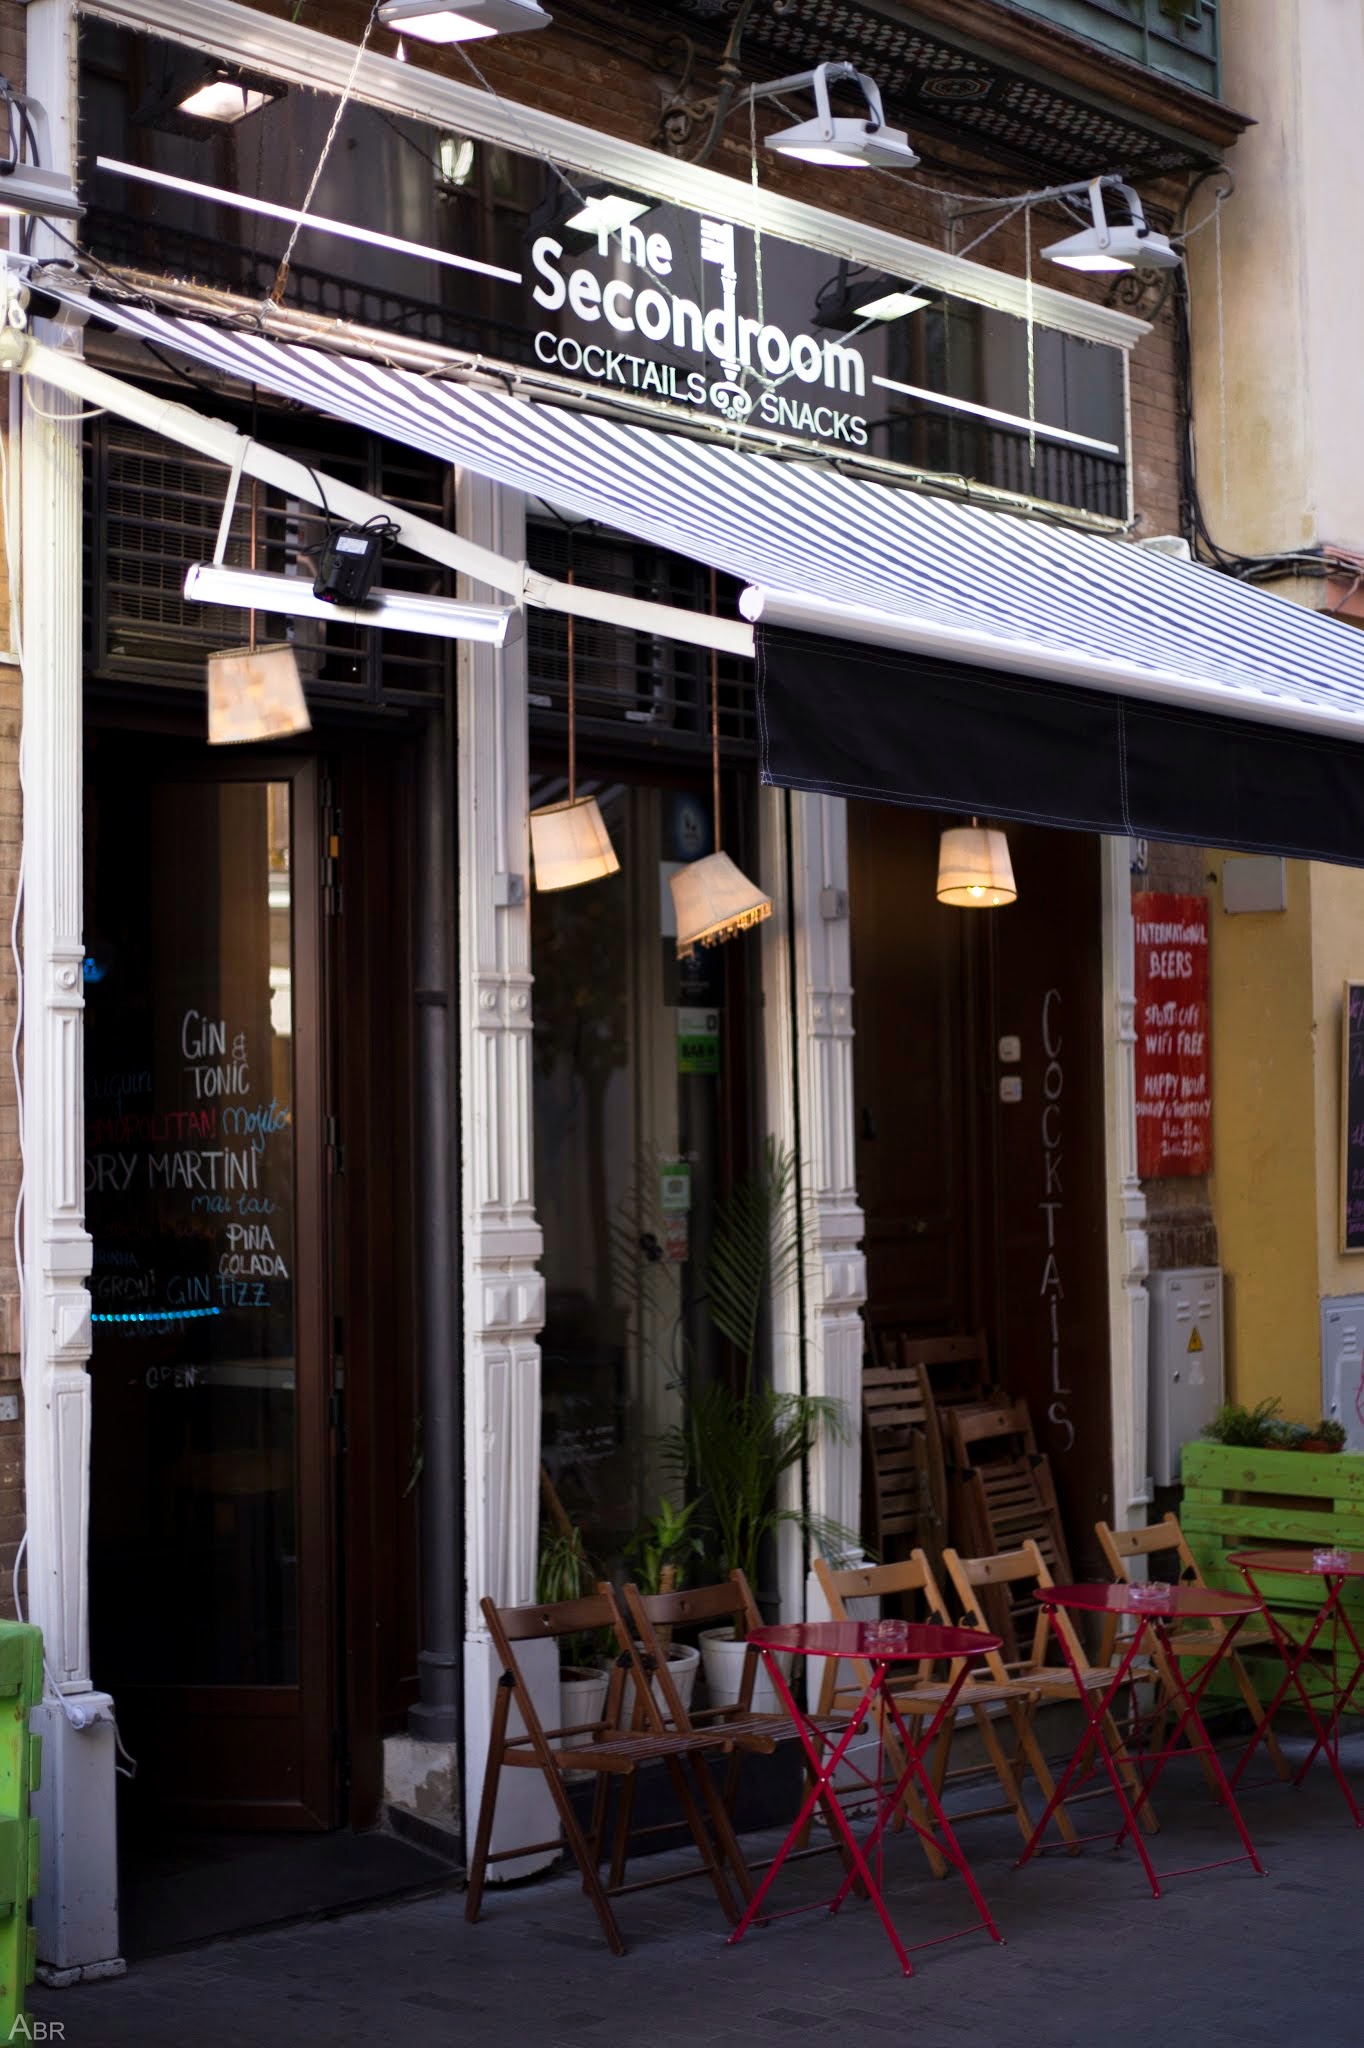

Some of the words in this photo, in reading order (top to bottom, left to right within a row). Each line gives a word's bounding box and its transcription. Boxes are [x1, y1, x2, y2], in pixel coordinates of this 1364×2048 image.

[597, 207, 673, 275] The
[531, 236, 866, 397] Secondroom
[533, 331, 708, 405] COCKTAILS
[759, 392, 868, 446] SNACKS
[1149, 950, 1193, 979] BEERS
[1176, 1029, 1205, 1056] FREE
[1144, 1072, 1179, 1098] HAPPY
[1039, 988, 1074, 1452] COCKTAILS
[218, 1252, 288, 1279] COLADA
